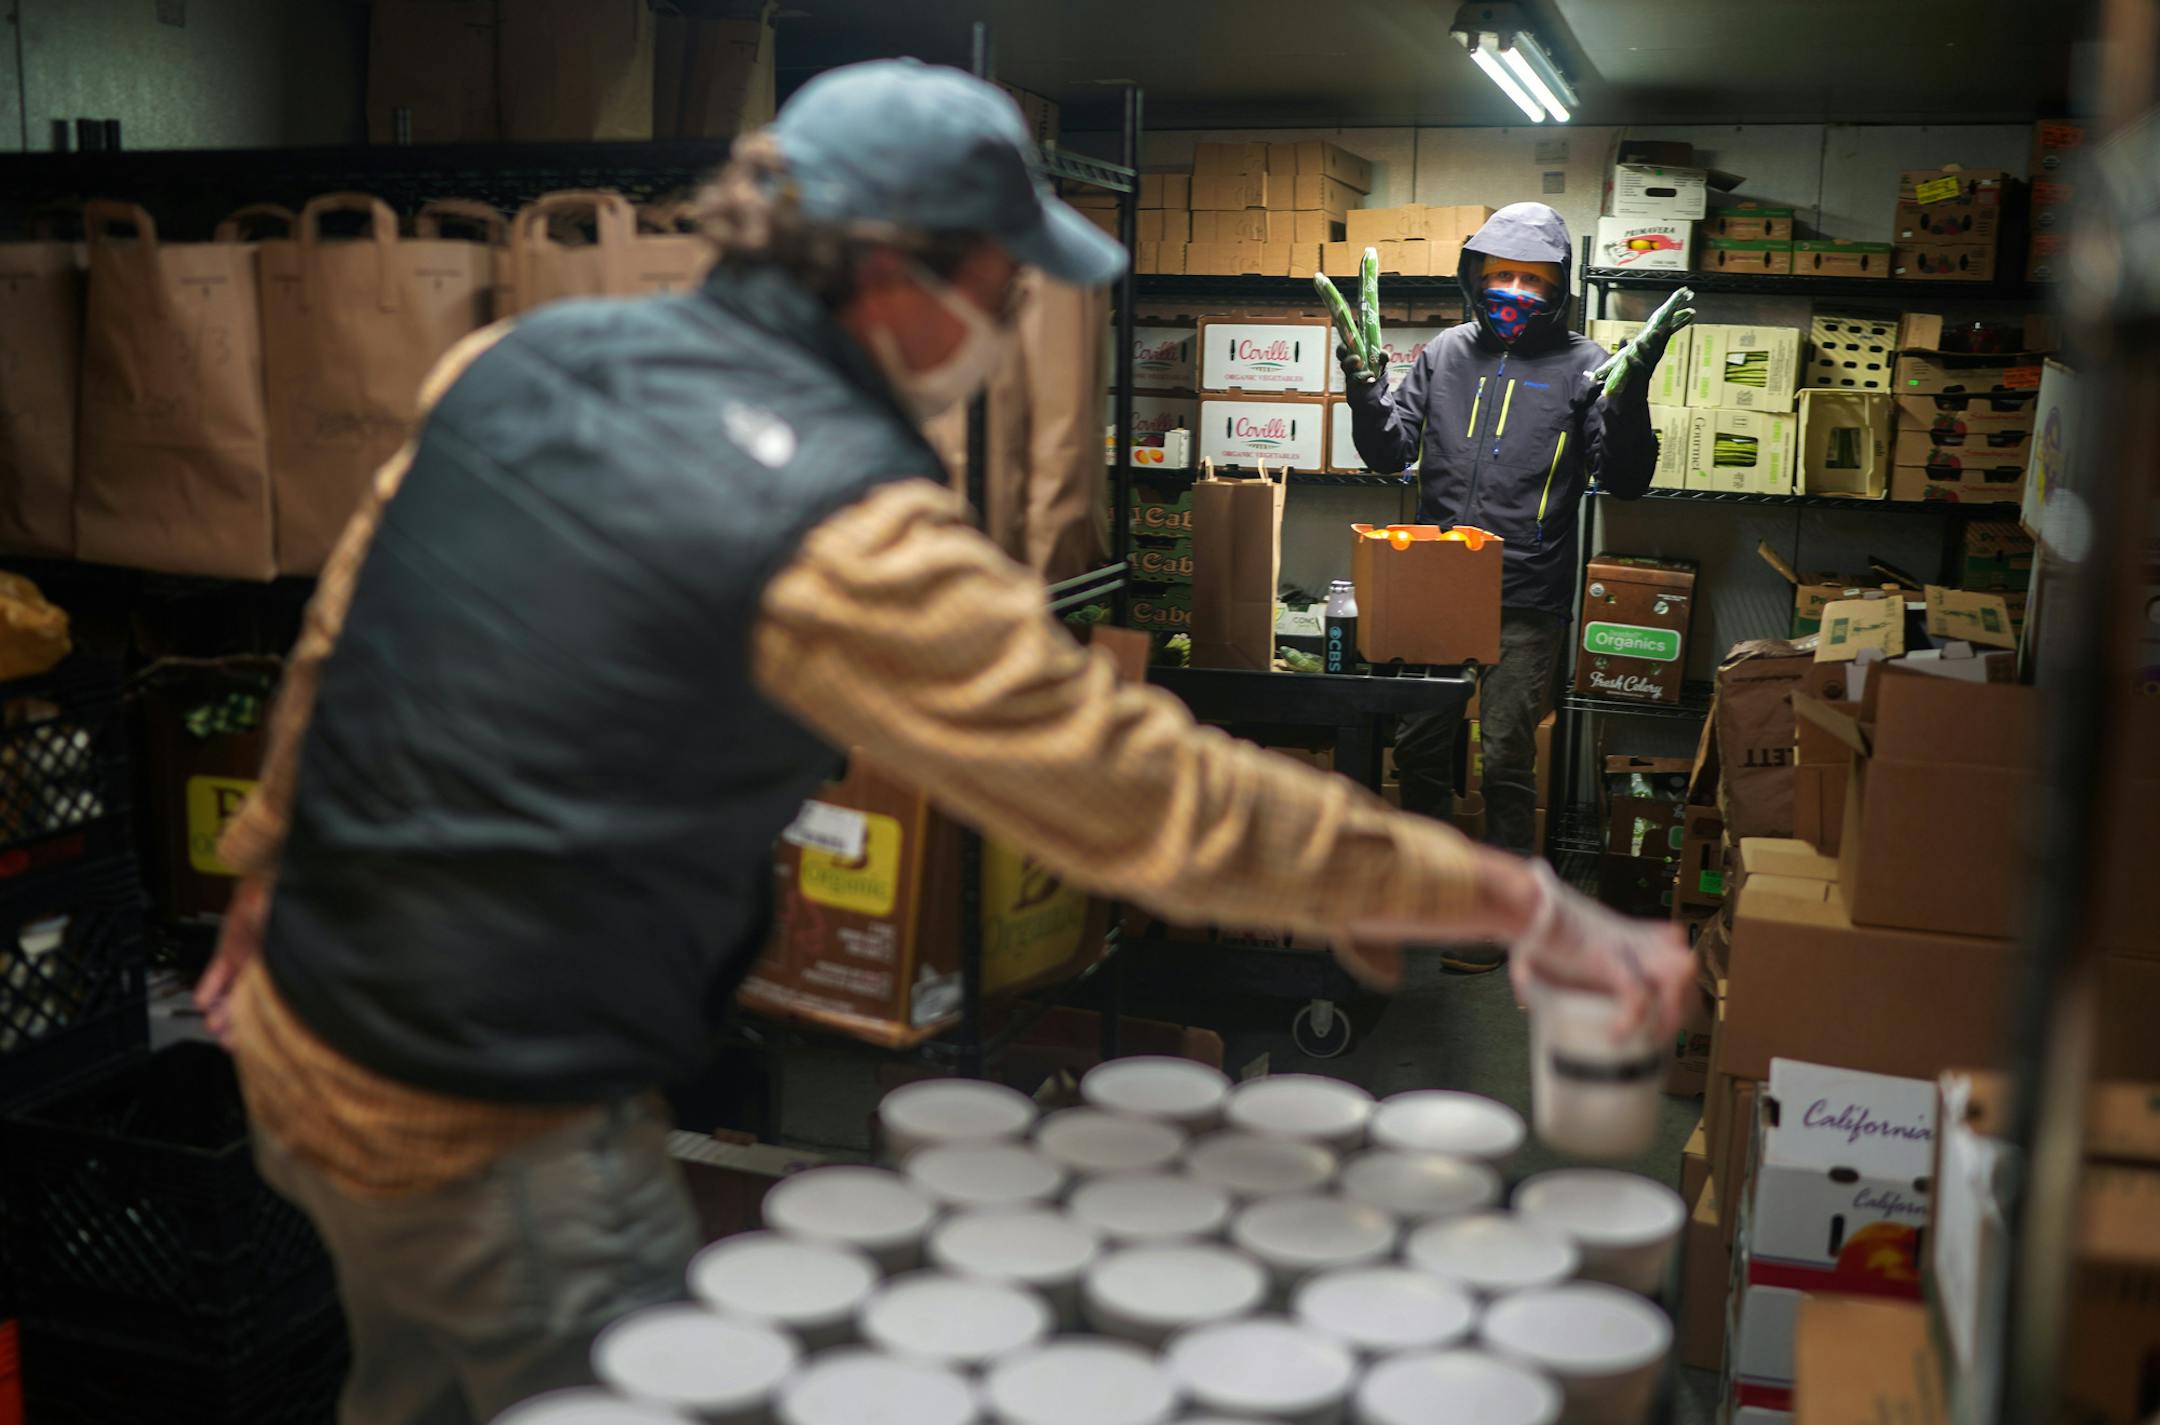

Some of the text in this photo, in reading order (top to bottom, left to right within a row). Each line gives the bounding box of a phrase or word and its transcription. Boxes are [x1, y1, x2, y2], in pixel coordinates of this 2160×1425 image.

[1239, 339, 1291, 361] Covilli
[1235, 417, 1287, 439] Covilli
[1595, 631, 1666, 653] Organics
[1328, 639, 1342, 673] CBS
[1590, 671, 1664, 699] Fresh Celery
[1803, 1099, 1934, 1144] California
